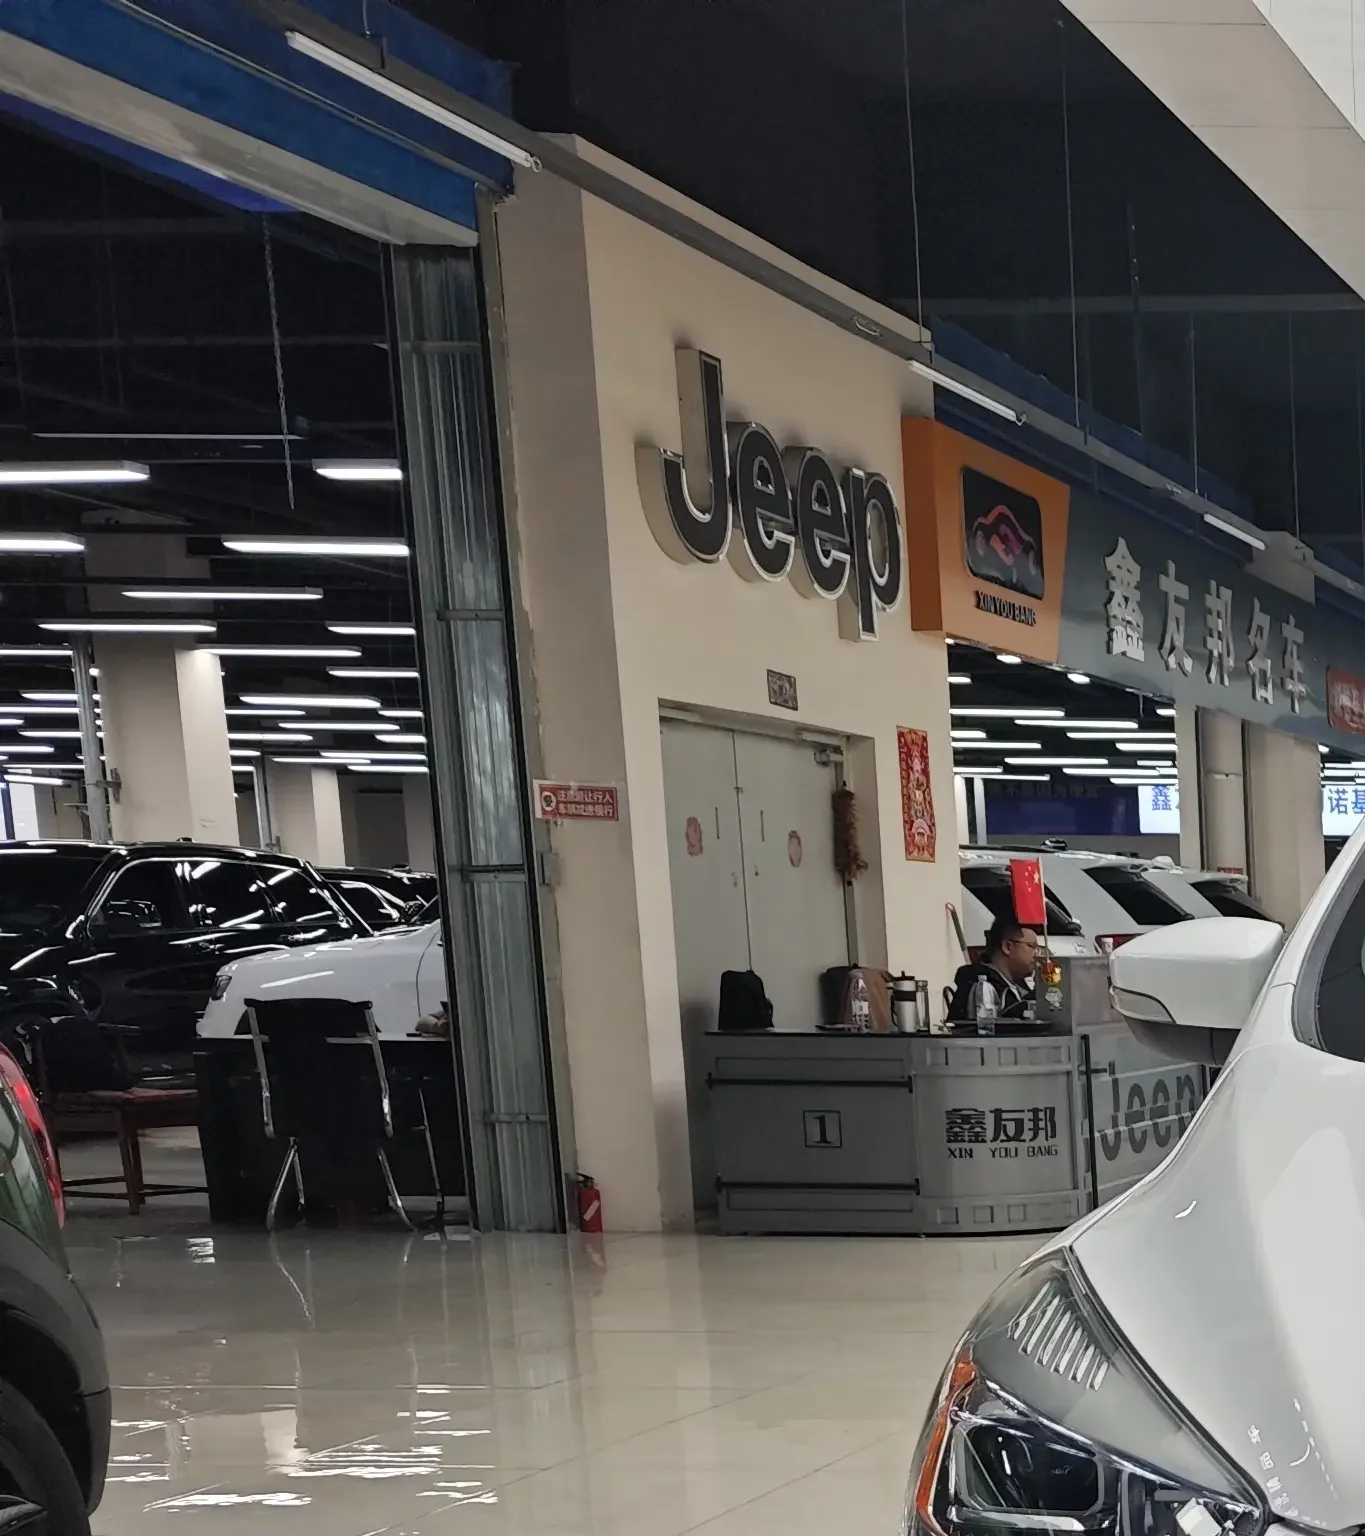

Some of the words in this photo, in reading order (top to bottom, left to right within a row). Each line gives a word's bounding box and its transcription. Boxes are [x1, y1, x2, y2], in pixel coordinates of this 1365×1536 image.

[636, 348, 902, 643] Jeep
[1104, 537, 1307, 714] 鑫友邦名车
[1152, 784, 1180, 811] 鑫
[813, 1114, 834, 1145] 1
[945, 1106, 1057, 1143] 鑫友邦
[947, 1147, 974, 1159] XIN
[989, 1146, 1018, 1159] YOU
[1027, 1144, 1058, 1158] BANG
